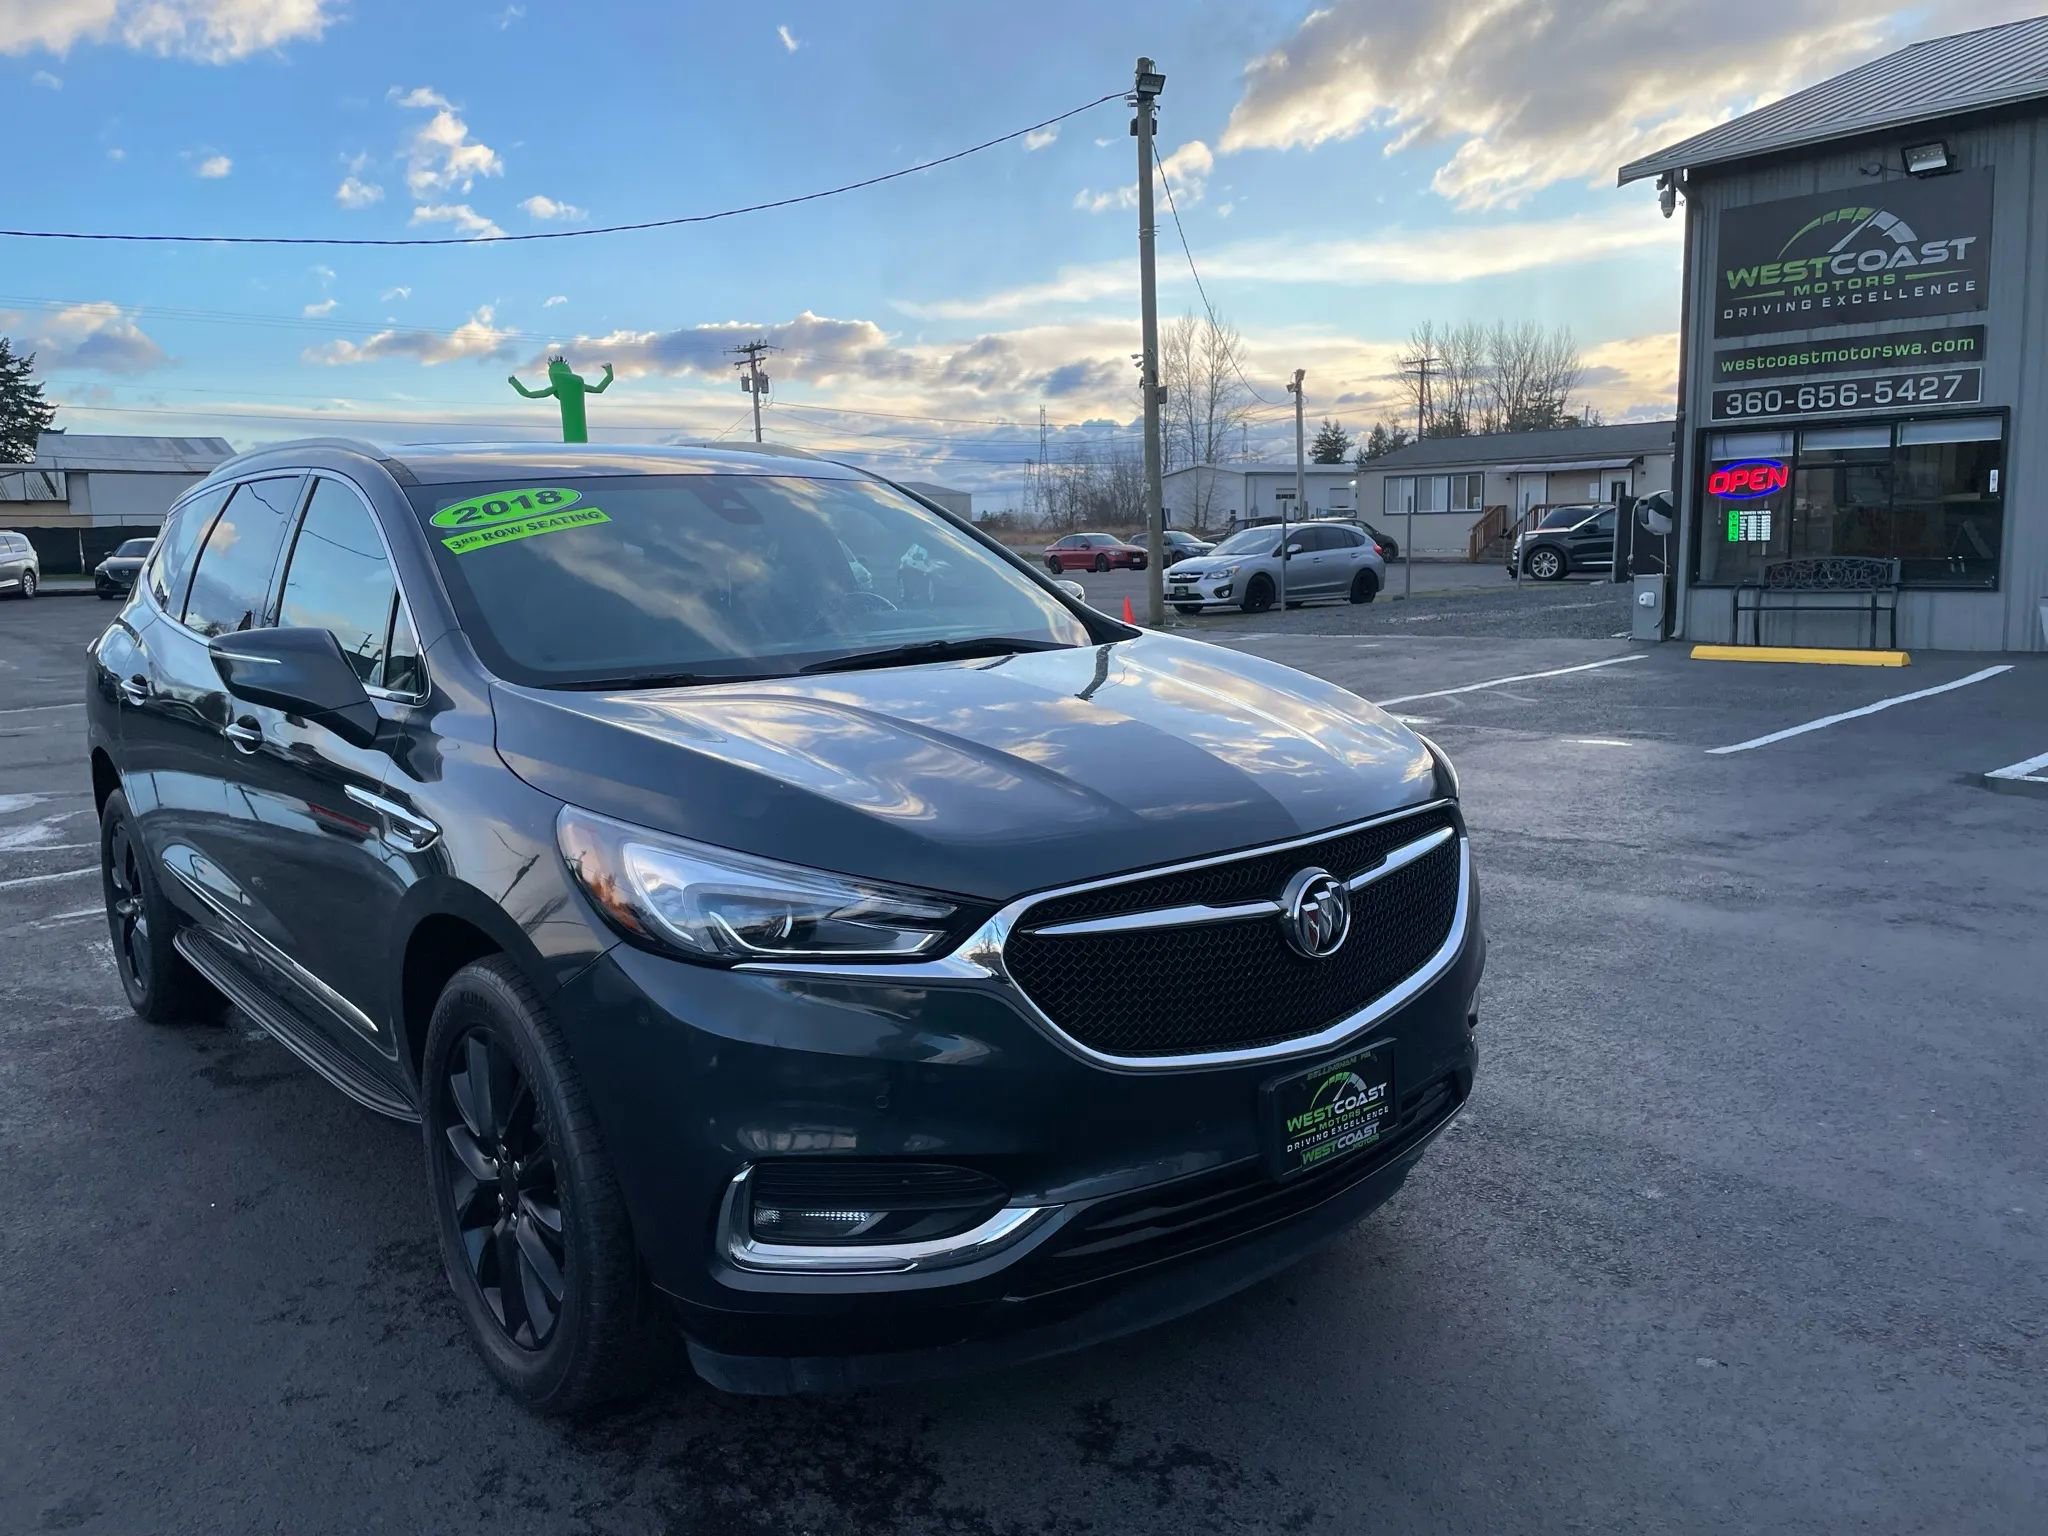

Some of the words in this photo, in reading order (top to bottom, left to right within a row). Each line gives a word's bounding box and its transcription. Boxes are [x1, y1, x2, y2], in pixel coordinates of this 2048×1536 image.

[1723, 299, 1812, 320] DRIVING
[1822, 280, 1977, 308] EXCELLENCE
[1793, 273, 1896, 297] MOTORS
[1720, 336, 1975, 374] westcoastmotorswa.com
[1725, 374, 1964, 416] 360-656-5427
[1708, 464, 1789, 494] OPEN
[452, 490, 563, 525] 2018
[481, 525, 523, 541] ROW
[526, 511, 601, 532] SEATING
[1286, 1130, 1329, 1153] DRIVING
[1331, 1105, 1390, 1135] EXCELLENCE
[1319, 1108, 1361, 1131] MOTORS
